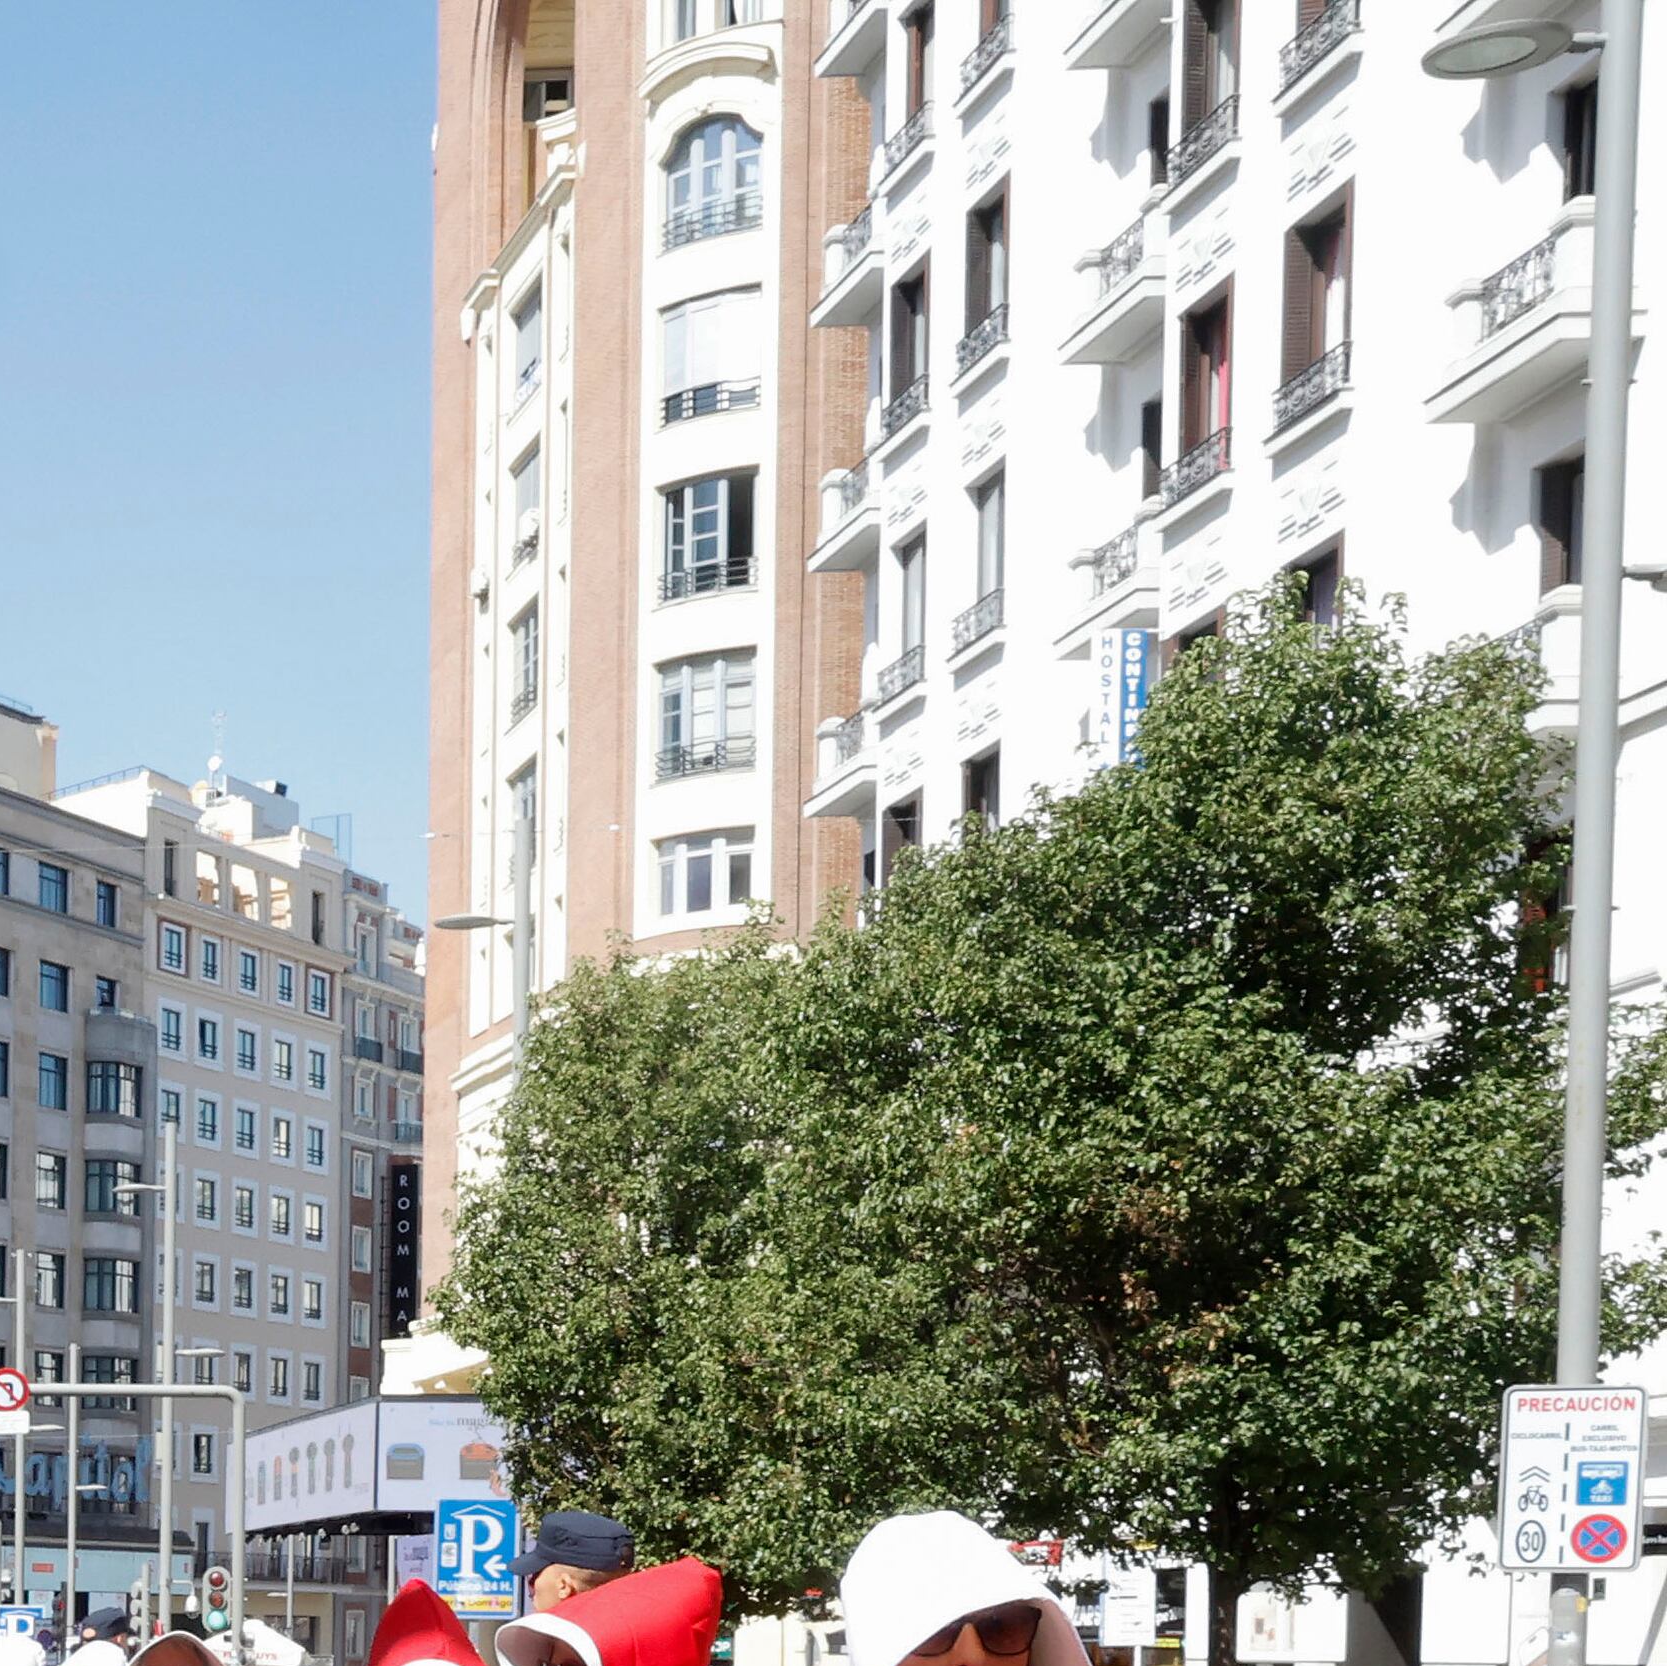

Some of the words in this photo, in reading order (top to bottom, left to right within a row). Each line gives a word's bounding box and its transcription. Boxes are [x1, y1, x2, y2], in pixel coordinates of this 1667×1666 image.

[1100, 636, 1113, 744] HOSTAL
[397, 1174, 410, 1256] ROOM
[1517, 1394, 1636, 1412] PRECAUCIÓN
[453, 1514, 503, 1578] P
[1521, 1531, 1540, 1552] 30
[483, 1581, 497, 1592] 24
